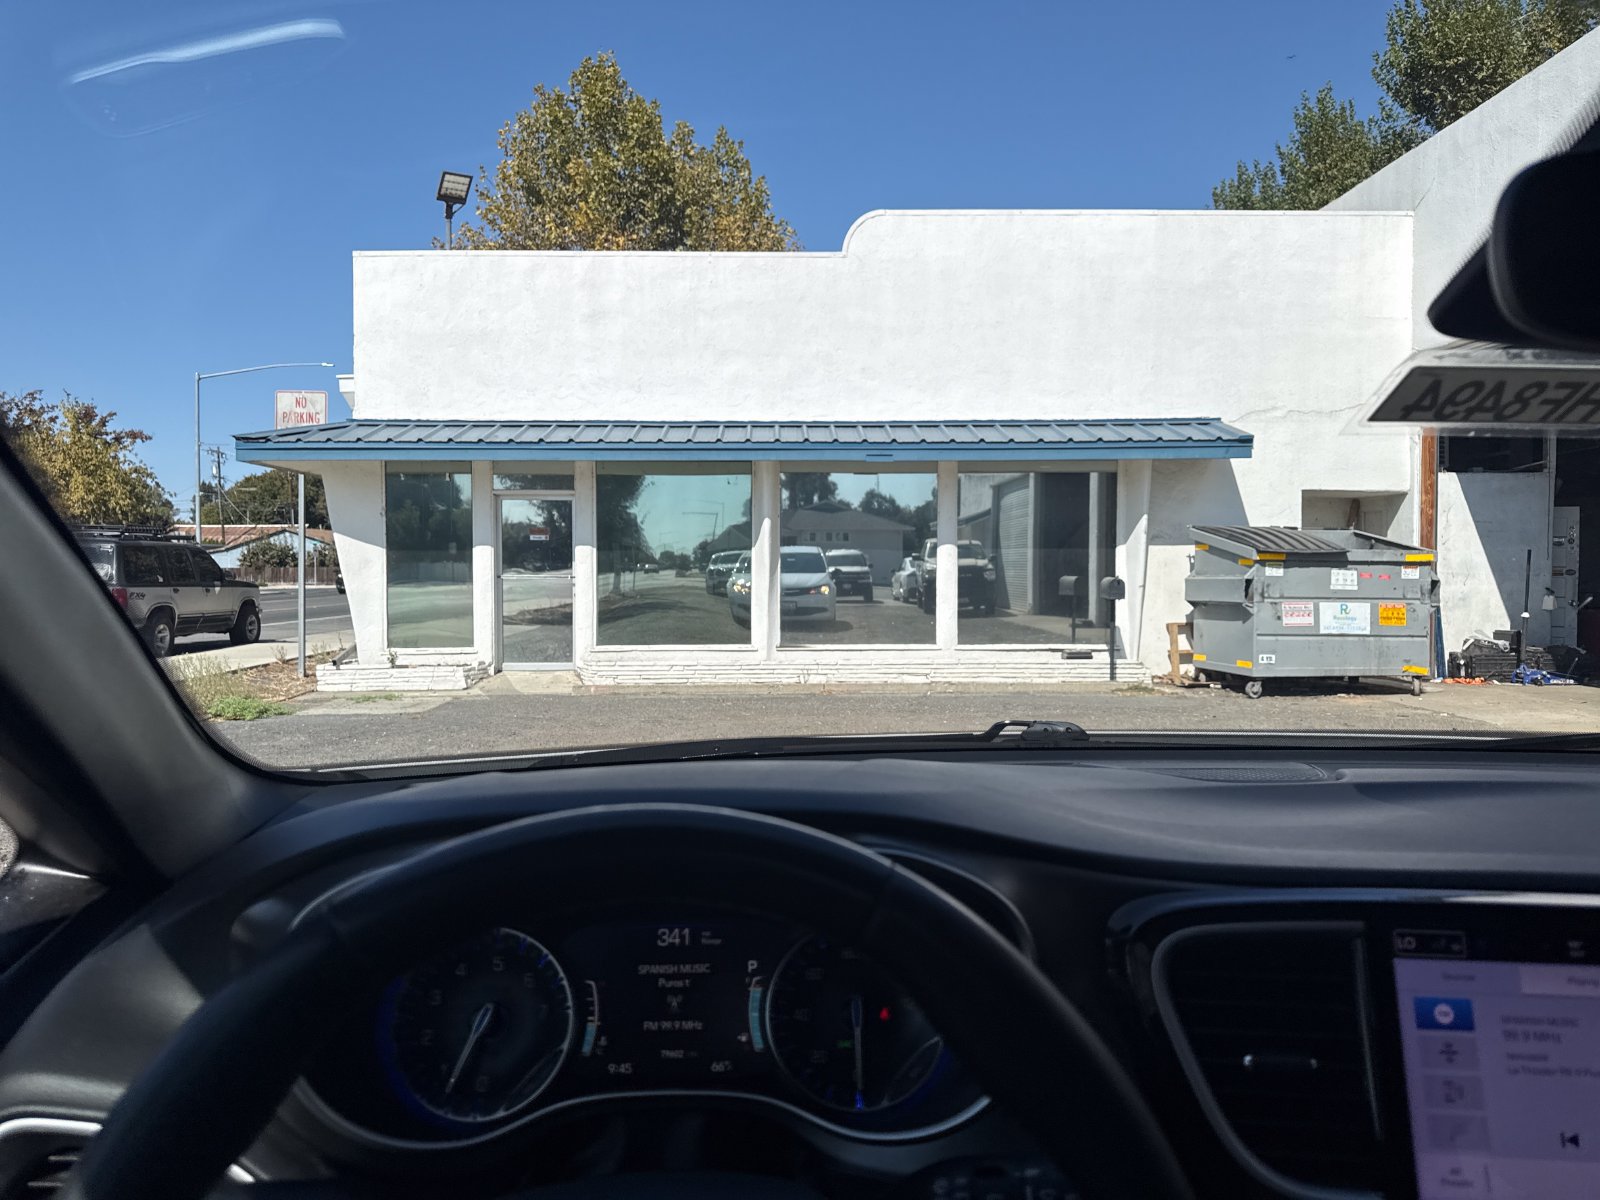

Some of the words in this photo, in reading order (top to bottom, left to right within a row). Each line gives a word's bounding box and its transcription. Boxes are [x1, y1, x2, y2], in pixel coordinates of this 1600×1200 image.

[295, 396, 307, 409] NO
[282, 411, 320, 424] PARKING
[657, 927, 690, 947] 341
[680, 963, 711, 974] MUSIC
[748, 960, 758, 973] P
[608, 1063, 633, 1075] 9:45
